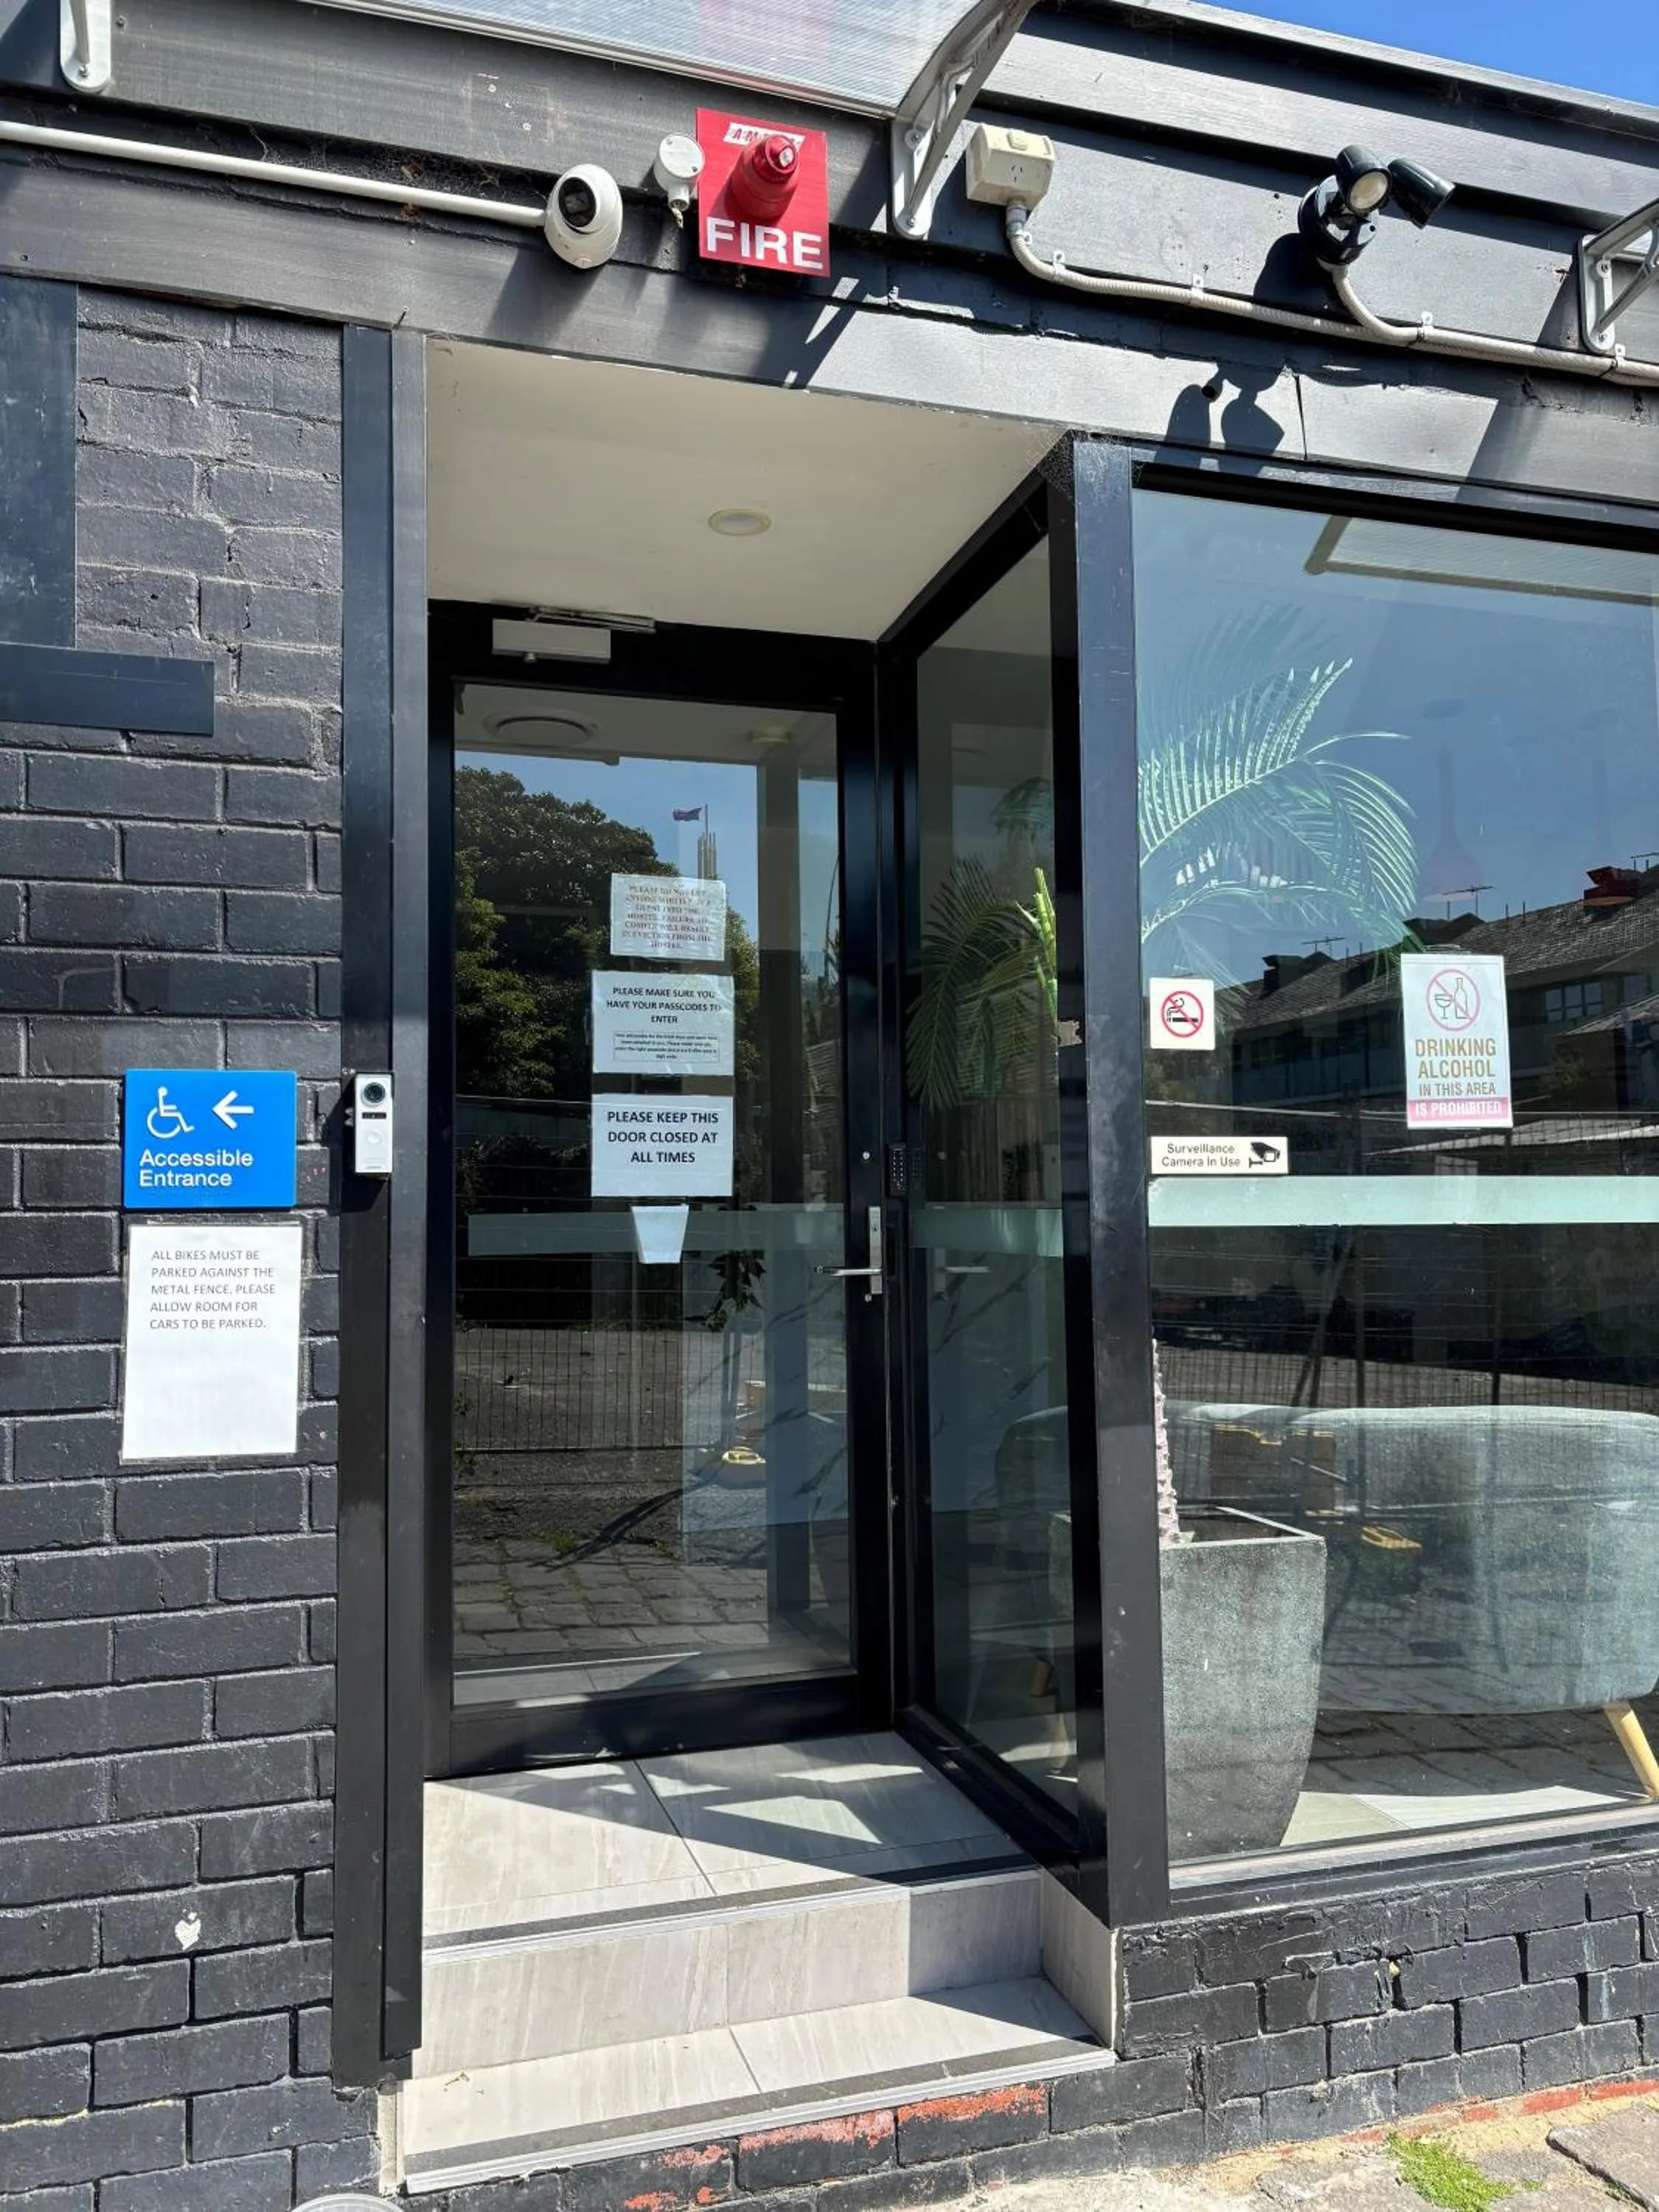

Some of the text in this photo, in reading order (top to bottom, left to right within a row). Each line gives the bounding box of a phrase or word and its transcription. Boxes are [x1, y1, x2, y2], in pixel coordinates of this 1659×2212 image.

[707, 217, 823, 269] FIRE
[613, 987, 715, 998] PLEASE MAKE SURE YOU
[607, 1001, 722, 1012] HAVE YOUR PASSCODES TO
[651, 1015, 678, 1023] ENTER
[1415, 1038, 1496, 1057] DRINKING
[1418, 1060, 1495, 1078] ALCOHOL
[1419, 1082, 1496, 1096] IN THIS AREA
[1415, 1101, 1501, 1117] IS PROHIBITED
[608, 1111, 719, 1123] PLEASE KEEP THIS
[608, 1132, 718, 1143] DOOR CLOSED AT
[1167, 1144, 1234, 1154] Surveillance
[139, 1148, 254, 1166] Accessible
[630, 1152, 695, 1163] ALL TIMES
[1161, 1157, 1204, 1167] Camera
[1220, 1157, 1241, 1167] Use
[139, 1169, 232, 1187] Entrance
[151, 1251, 260, 1261] ALL BIKES MUST BE
[151, 1267, 274, 1278] PARKED AGAINST THE
[151, 1284, 190, 1295] METAL
[236, 1284, 276, 1294] PLEASE
[150, 1301, 257, 1312] ALLOW ROOM FOR
[150, 1318, 266, 1329] CARS TO BE PARKED.
